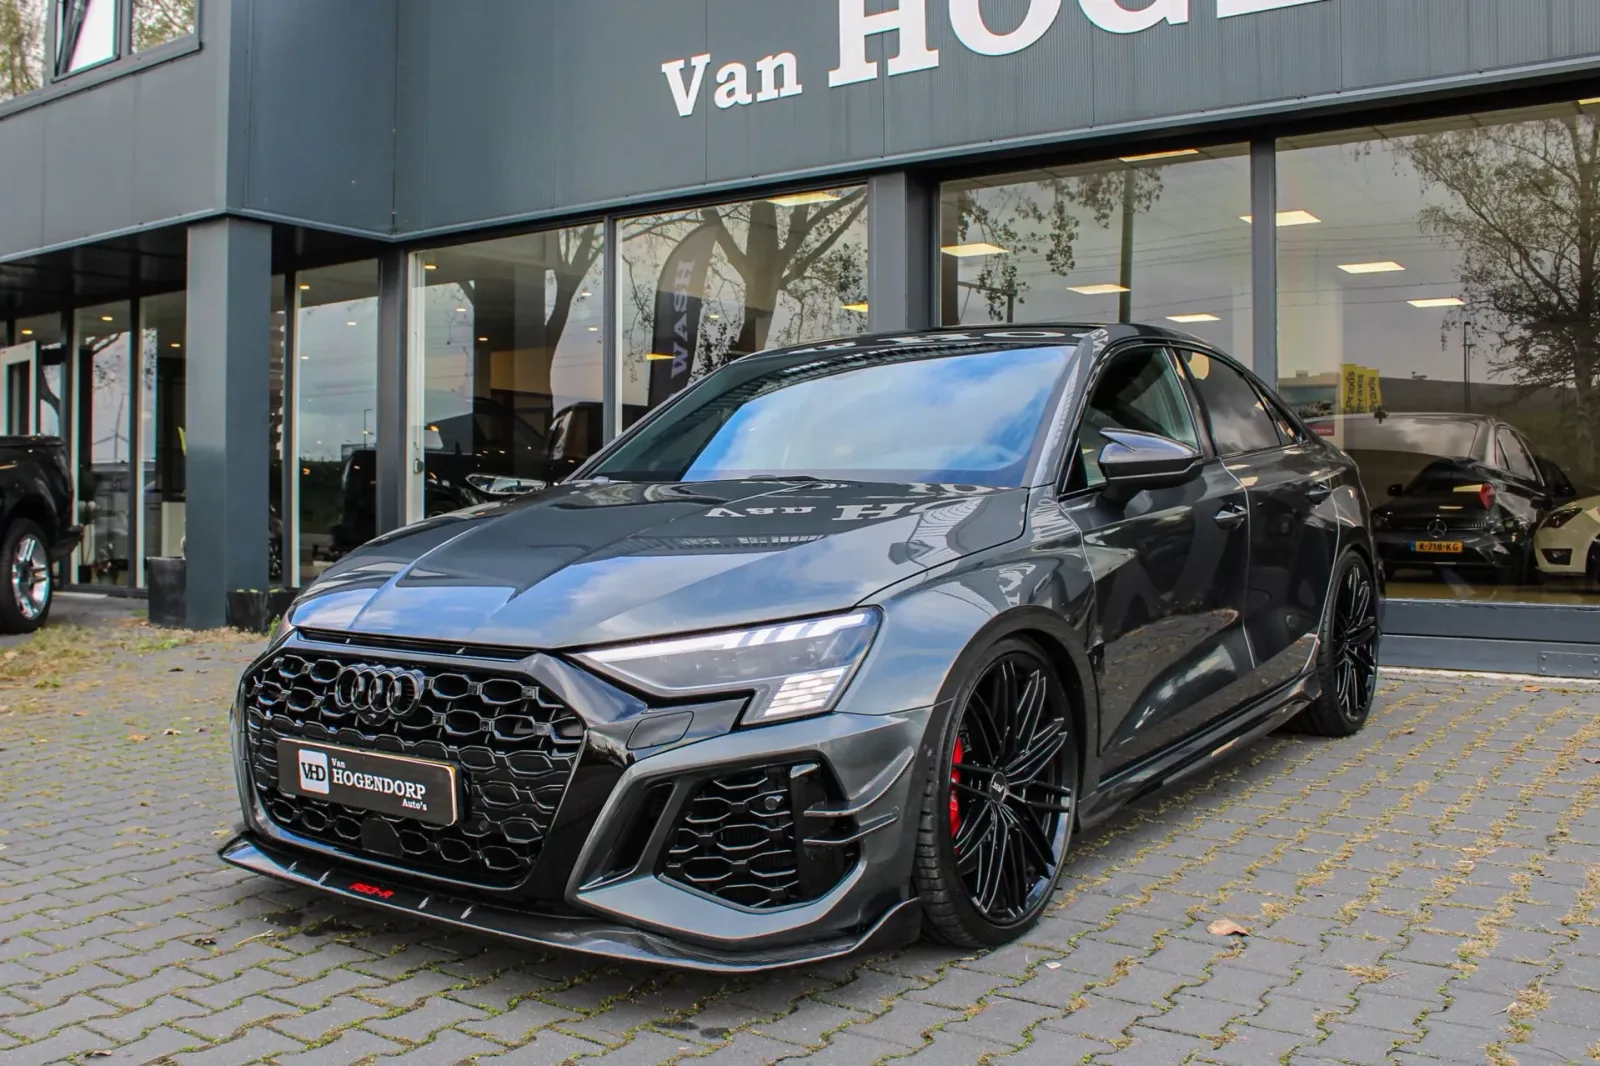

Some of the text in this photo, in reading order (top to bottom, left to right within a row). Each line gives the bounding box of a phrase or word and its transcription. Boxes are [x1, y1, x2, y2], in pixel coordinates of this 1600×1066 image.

[661, 53, 802, 117] Van
[671, 259, 695, 379] WASH
[331, 758, 346, 768] Van
[332, 769, 425, 799] HOGENDORP
[402, 799, 428, 812] Auto's
